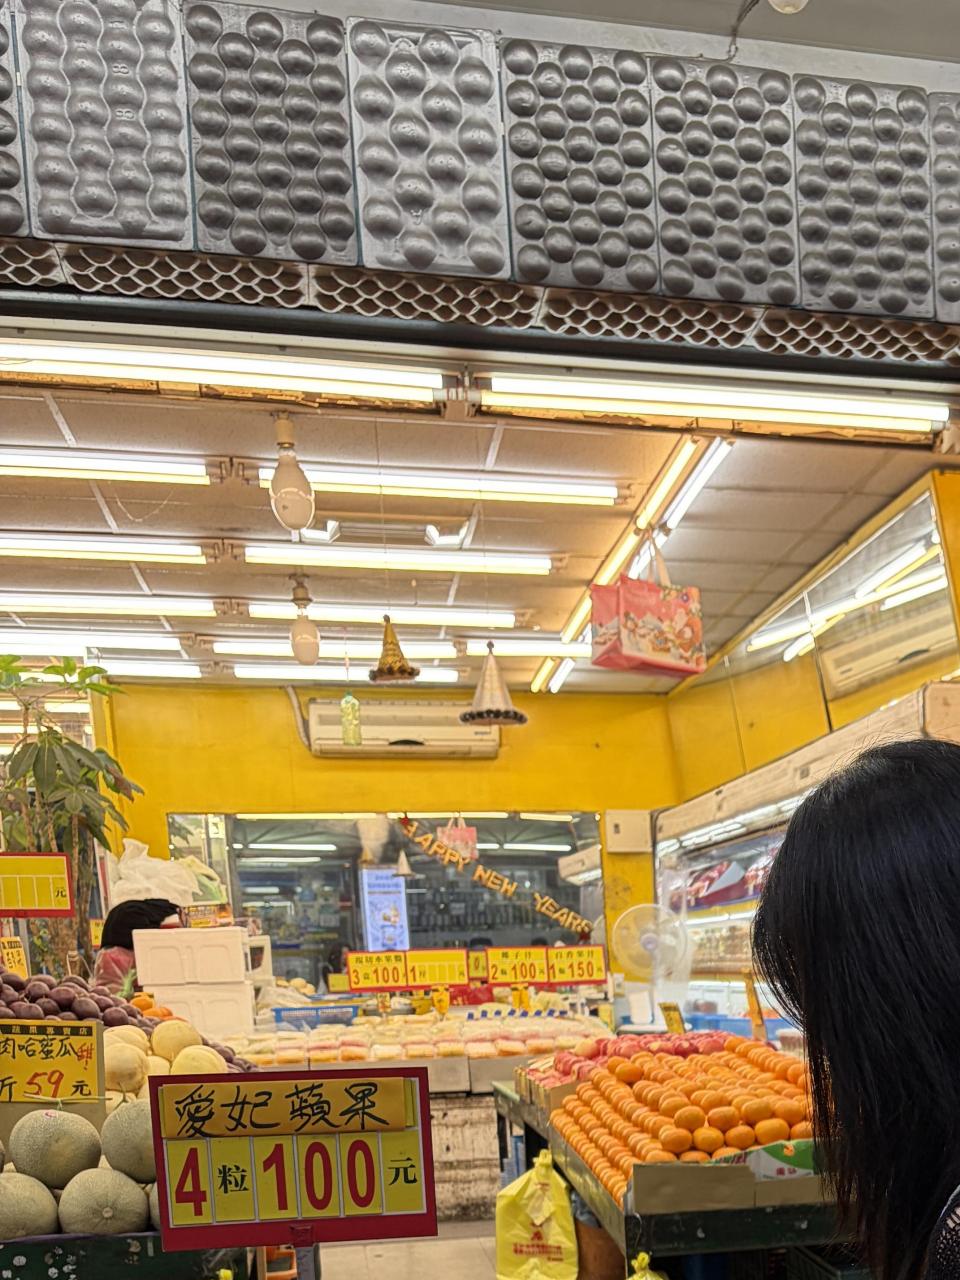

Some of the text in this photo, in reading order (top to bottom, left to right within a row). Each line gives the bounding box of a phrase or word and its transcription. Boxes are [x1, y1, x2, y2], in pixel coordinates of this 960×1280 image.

[472, 864, 518, 897] NEW
[174, 1083, 390, 1138] 愛妃蘋果
